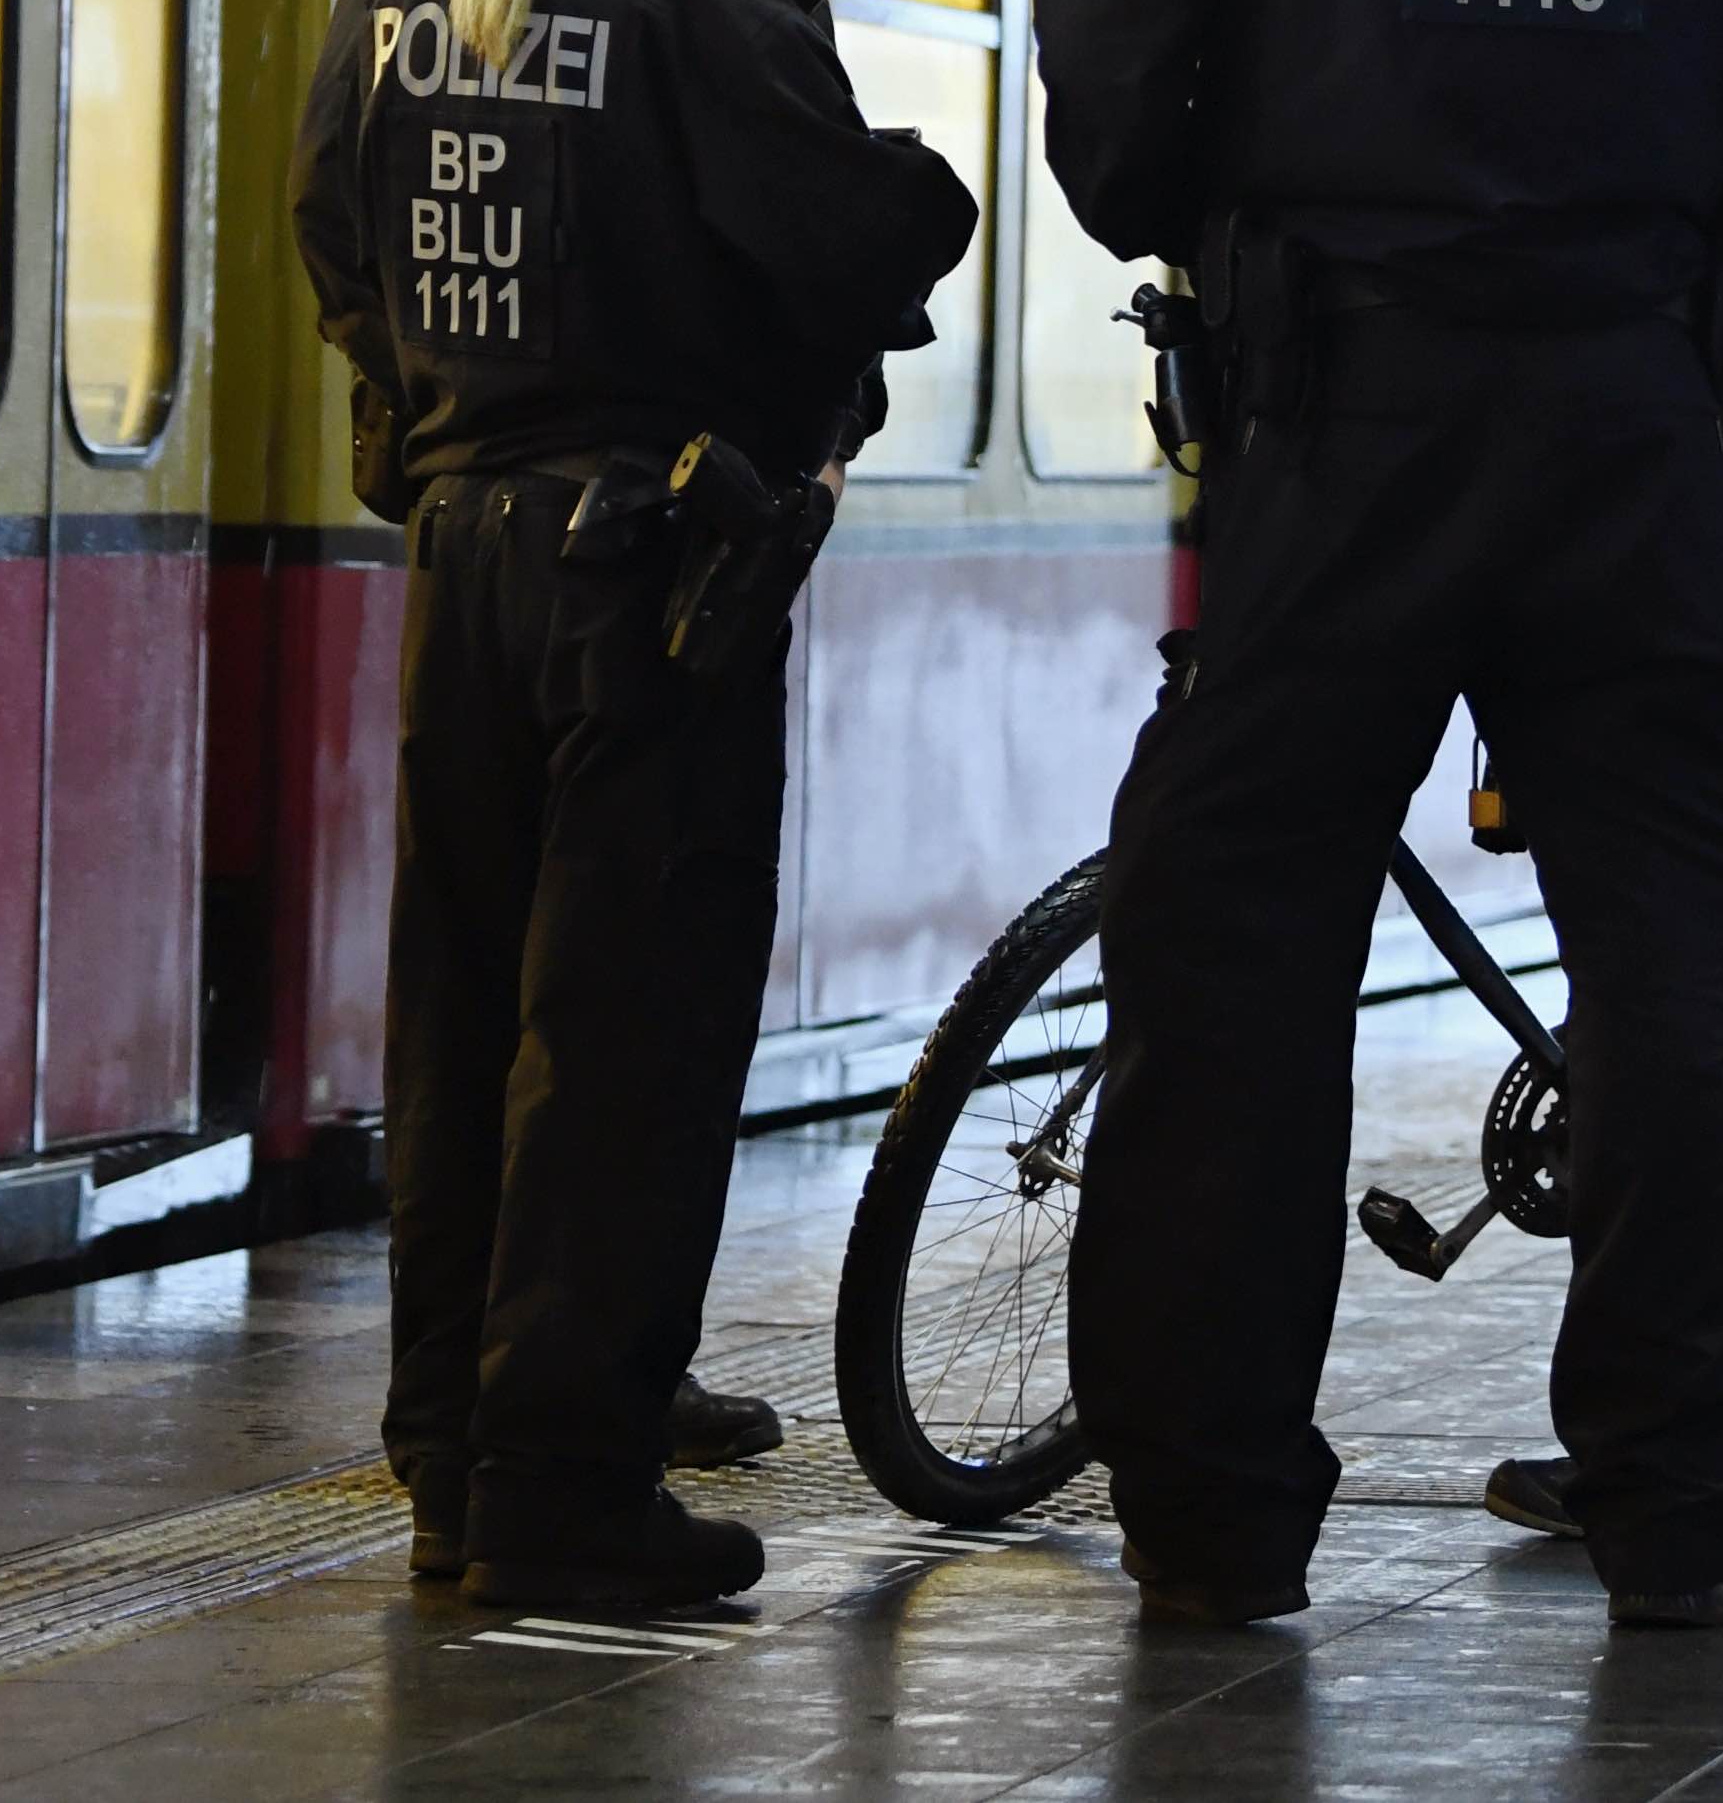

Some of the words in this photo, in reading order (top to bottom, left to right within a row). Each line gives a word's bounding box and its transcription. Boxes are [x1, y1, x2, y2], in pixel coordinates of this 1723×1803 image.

[430, 129, 506, 194] BP
[411, 198, 522, 268] BLU
[415, 270, 520, 340] 1111
